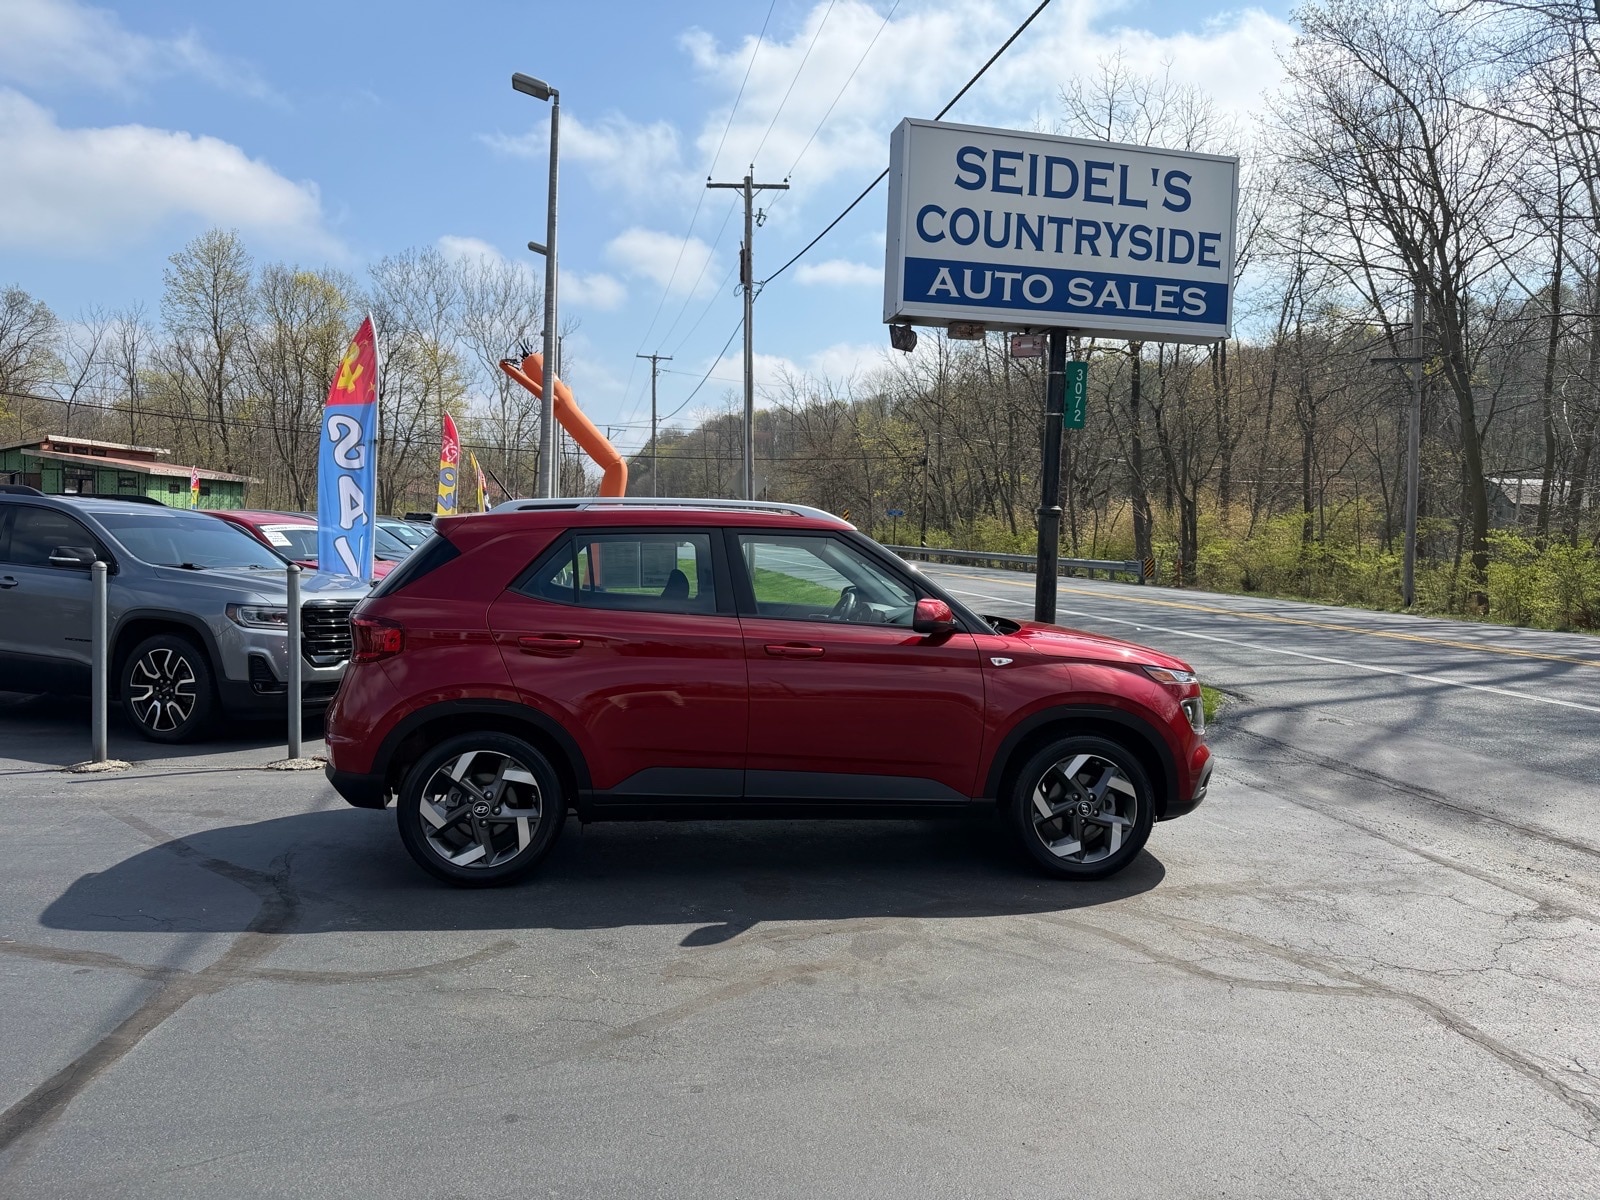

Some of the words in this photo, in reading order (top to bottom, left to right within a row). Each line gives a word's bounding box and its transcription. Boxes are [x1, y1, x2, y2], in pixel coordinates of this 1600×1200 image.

[954, 146, 1192, 213] SEIDEL'S
[916, 204, 1222, 269] COUNTRYSIDE
[926, 267, 1054, 304] AUTO
[1067, 277, 1207, 316] SALES
[1074, 368, 1083, 422] 3072
